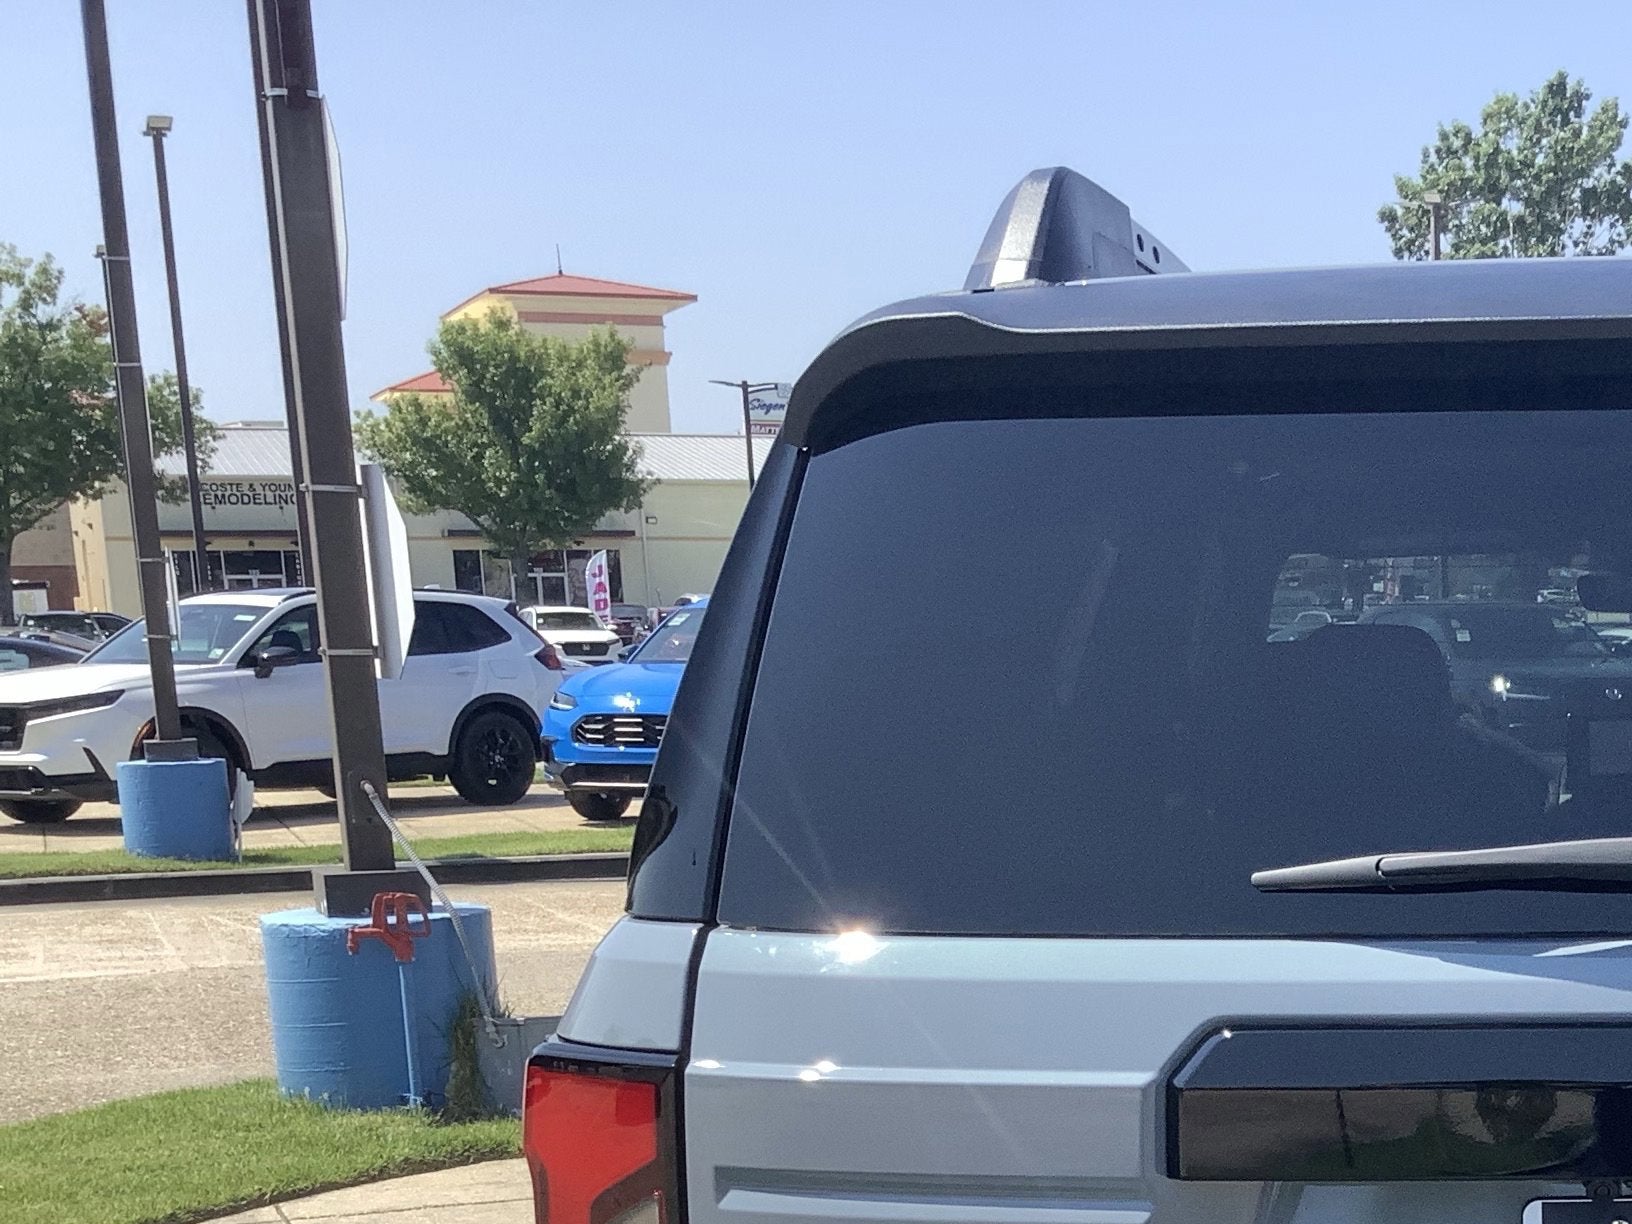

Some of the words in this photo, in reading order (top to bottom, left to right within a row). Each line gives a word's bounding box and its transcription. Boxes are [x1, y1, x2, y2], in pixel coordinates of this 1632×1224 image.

[199, 482, 244, 492] COSTE
[247, 482, 256, 492] &
[259, 482, 294, 493] YOUN
[201, 493, 296, 505] EMODELIN
